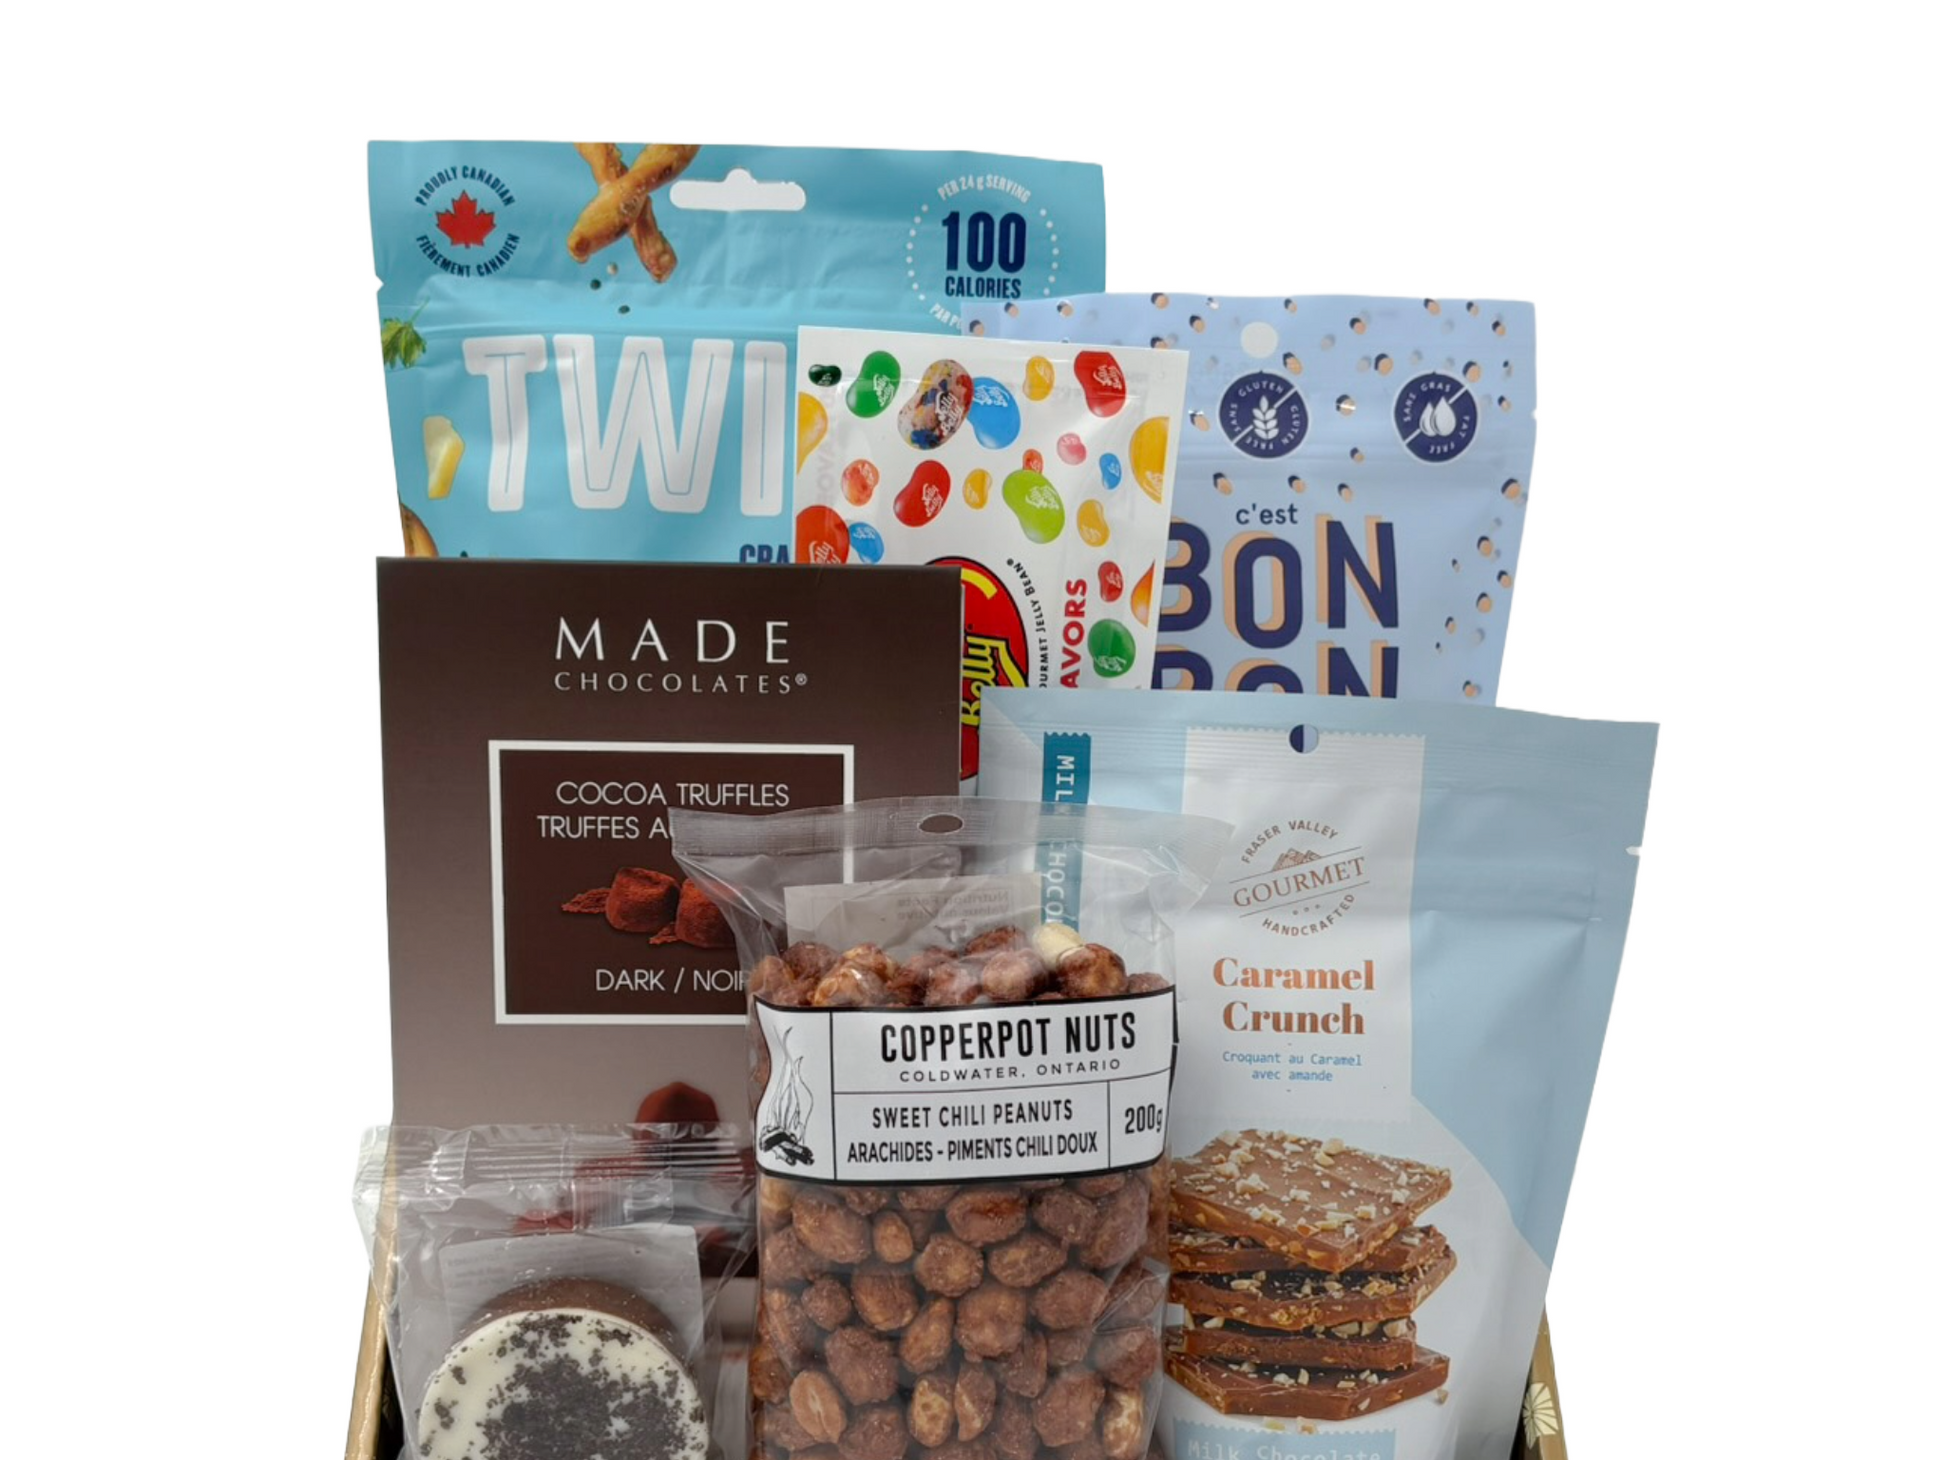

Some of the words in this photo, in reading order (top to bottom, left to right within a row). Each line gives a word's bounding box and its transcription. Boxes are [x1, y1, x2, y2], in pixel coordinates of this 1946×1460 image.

[415, 166, 458, 206] PROUDLY
[462, 165, 515, 206] CANADIAN
[938, 180, 960, 200] PER
[960, 174, 975, 191] 24
[986, 174, 1031, 203] SERVING
[416, 234, 471, 277] FIÈREMENT
[476, 233, 520, 276] CANADIEN
[942, 211, 1027, 273] 100
[945, 276, 1021, 299] CALORIES
[1238, 380, 1285, 397] GLUTEN
[1280, 405, 1301, 446] GLUTEN
[1403, 392, 1417, 423] SANS
[1420, 381, 1451, 393] GRAS
[462, 334, 787, 516] TWI
[1235, 503, 1298, 525] c'est
[1157, 514, 1399, 650] BON
[1029, 599, 1046, 633] JELLY
[555, 617, 790, 664] MADE
[1059, 578, 1087, 688] AVORS
[556, 781, 668, 806] COCOA
[677, 783, 790, 807] TRUFFLES
[1053, 754, 1075, 816] MIL
[537, 815, 640, 840] TRUFFES
[1241, 825, 1281, 864] FRASER
[1288, 819, 1339, 840] VALLEY
[1233, 856, 1365, 907] GOURMET
[1262, 893, 1355, 937] HANDCRAFTED
[595, 969, 666, 991] DARK
[674, 967, 685, 994] /
[1212, 957, 1375, 990] Caramel
[1222, 1001, 1366, 1034] Crunch
[880, 1017, 1051, 1063] COPPERPOT
[1064, 1012, 1137, 1054] NUTS
[1037, 1058, 1122, 1076] ONTARIO
[1222, 1051, 1281, 1066] Croquant
[1288, 1053, 1304, 1064] au
[1310, 1053, 1363, 1067] Caramel
[1251, 1069, 1281, 1081] avec
[1288, 1069, 1333, 1082] amande
[872, 1106, 932, 1129] SWEET
[938, 1104, 986, 1127] CHILI
[993, 1099, 1073, 1124] PEANUTS
[1123, 1103, 1163, 1135] 200g
[847, 1140, 934, 1163] ARACHIDES
[947, 1135, 1013, 1161] PIMENTS
[1015, 1133, 1054, 1158] CHILI
[1057, 1131, 1098, 1156] DOUX
[1187, 1439, 1240, 1460] Milk
